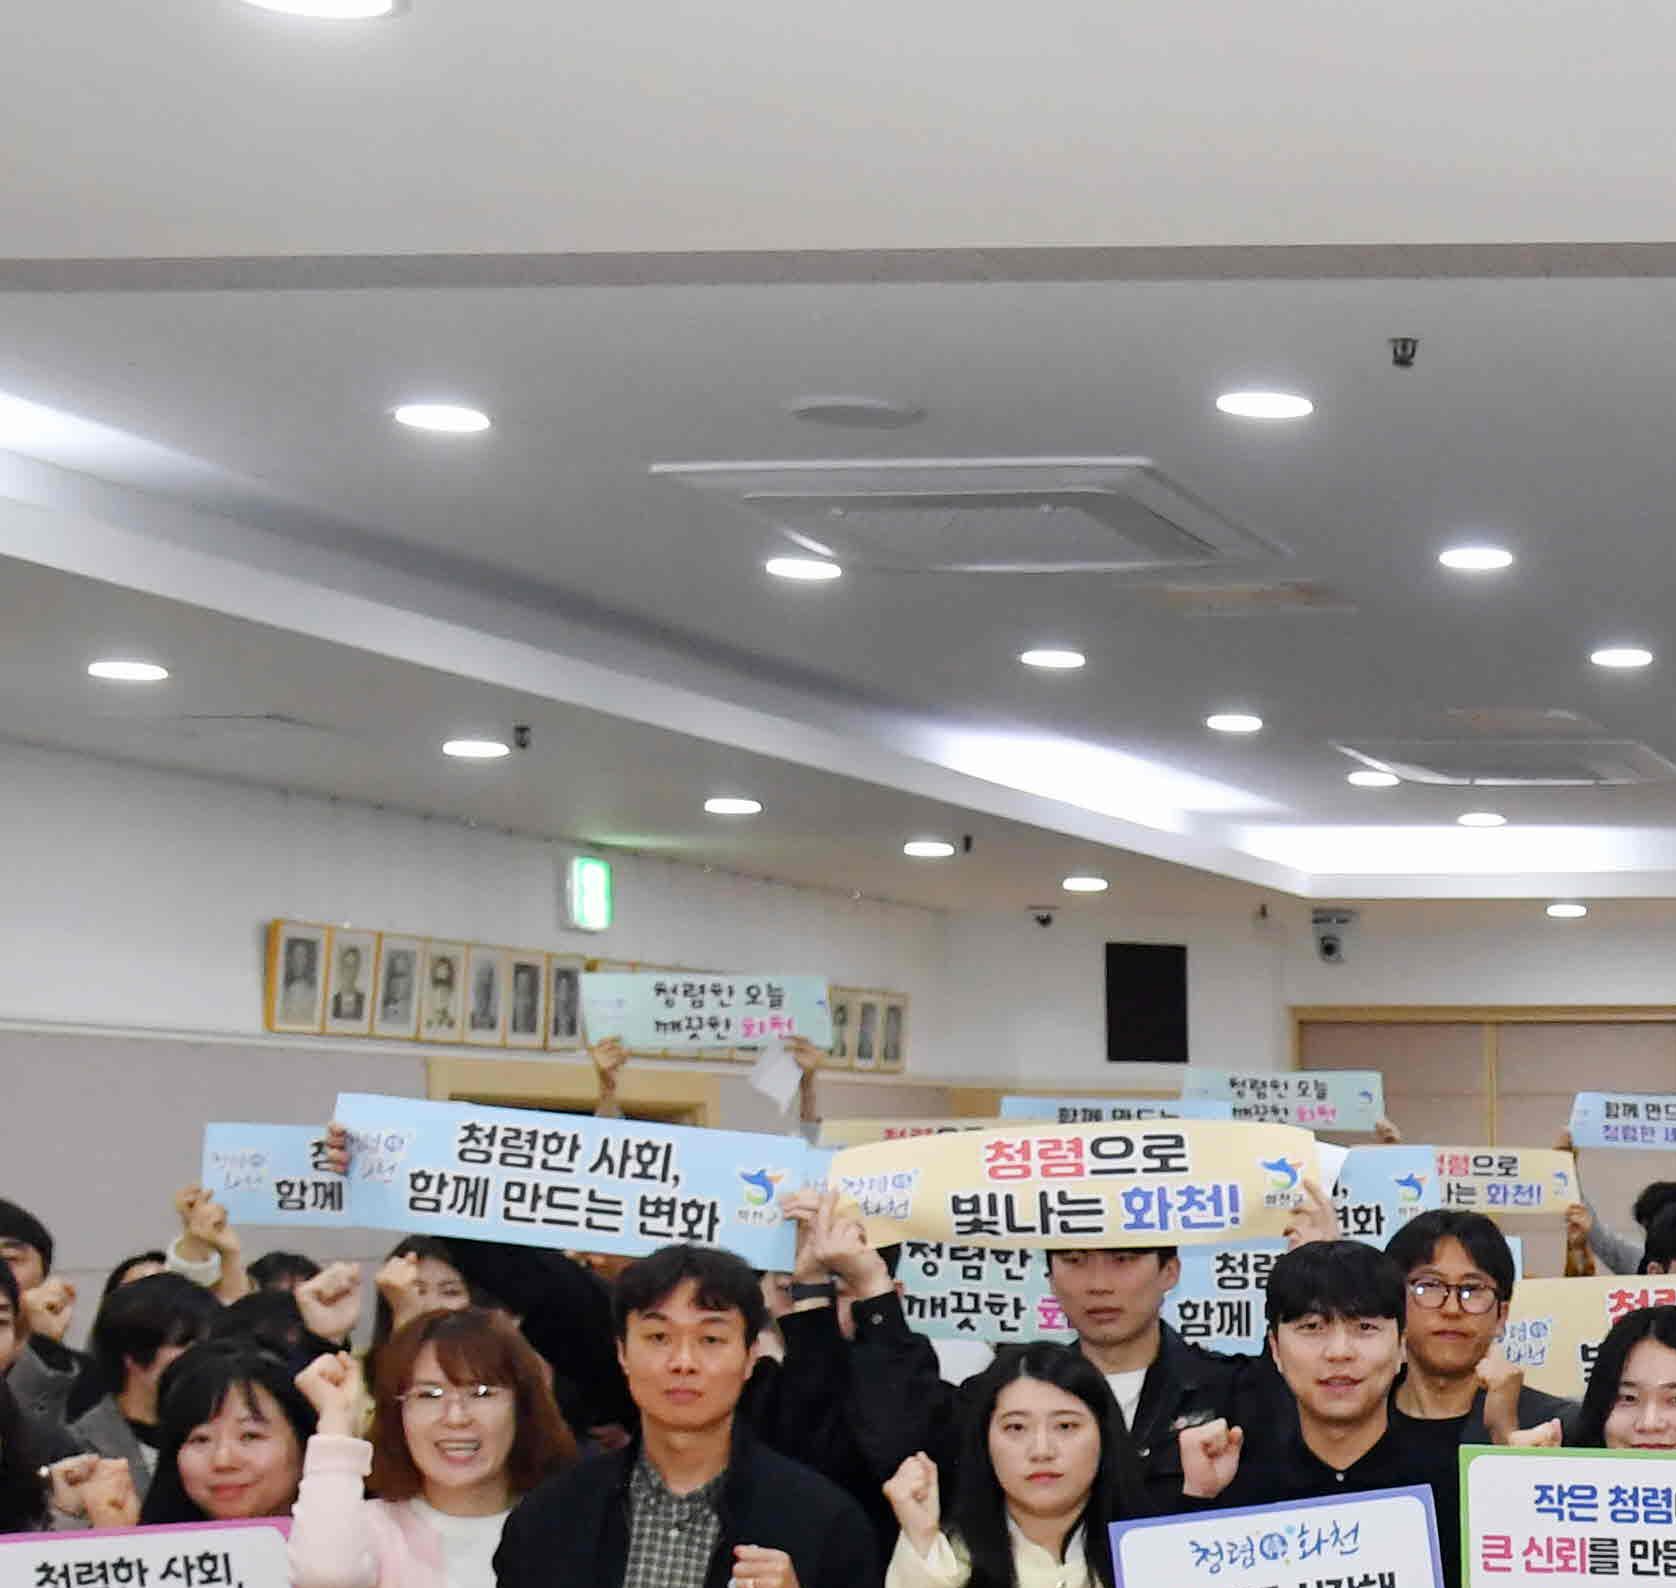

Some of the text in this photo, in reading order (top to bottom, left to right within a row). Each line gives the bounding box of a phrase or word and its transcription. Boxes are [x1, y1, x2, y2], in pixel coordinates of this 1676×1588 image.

[746, 983, 785, 1009] 오늘
[458, 1122, 580, 1174] 청렴한
[589, 1138, 680, 1187] 사회,
[985, 1133, 1189, 1180] 청렴으로
[276, 1180, 343, 1210] 함께
[409, 1169, 720, 1242] 함께 만드는 변화
[952, 1190, 1104, 1236] 빛나는
[1121, 1184, 1241, 1232] 화천!
[904, 1291, 1027, 1332] 깨끗한
[1178, 1301, 1250, 1336] 함께
[1534, 1484, 1599, 1523] 작은
[1481, 1535, 1512, 1574] 큰
[1522, 1536, 1619, 1575] 신뢰를
